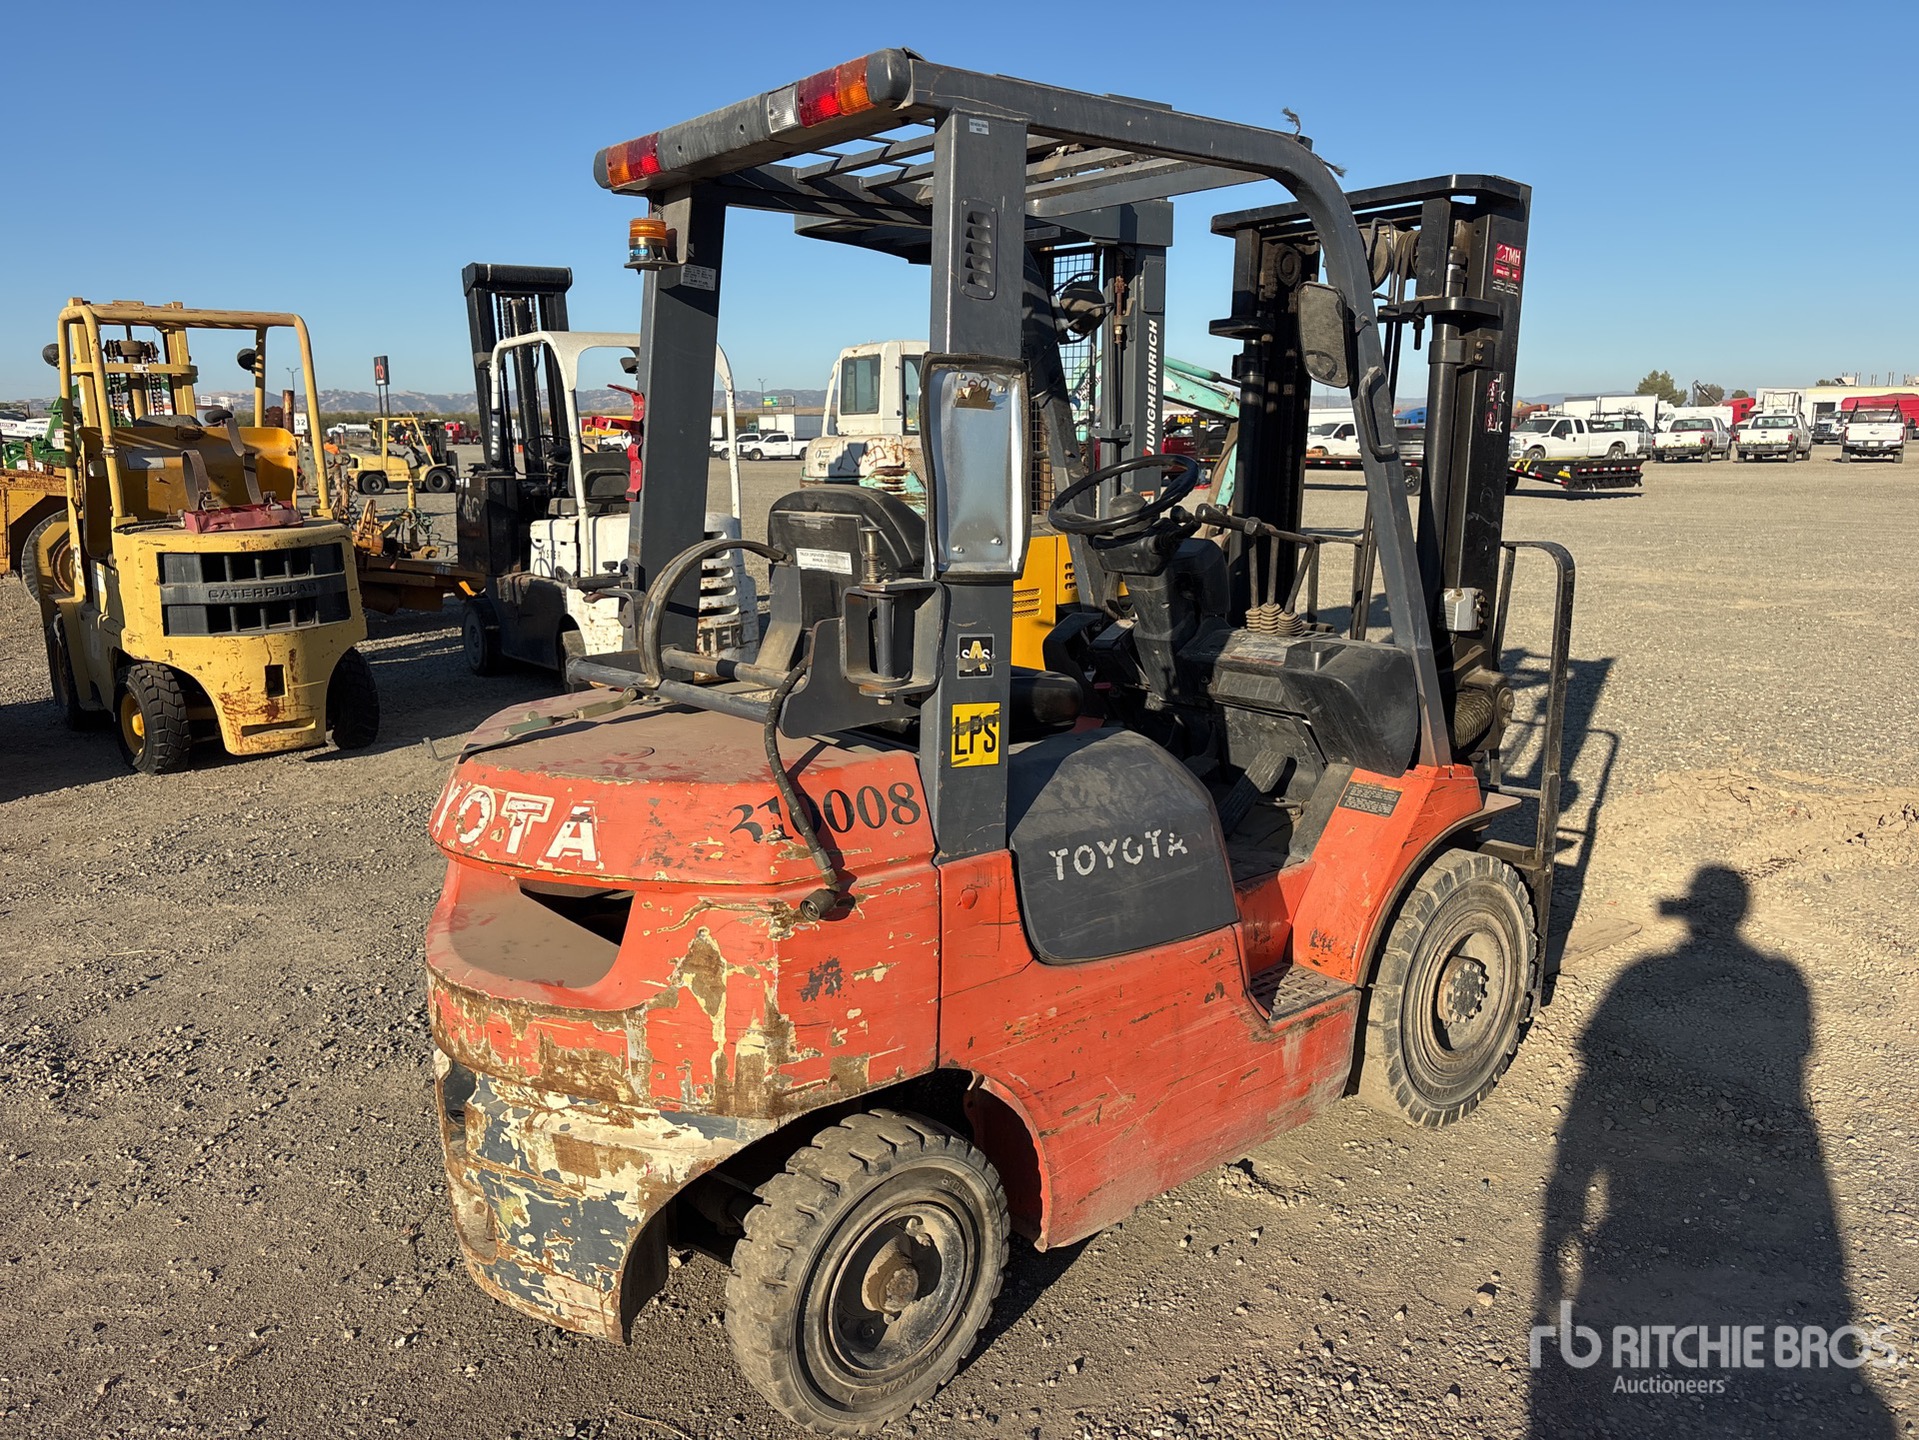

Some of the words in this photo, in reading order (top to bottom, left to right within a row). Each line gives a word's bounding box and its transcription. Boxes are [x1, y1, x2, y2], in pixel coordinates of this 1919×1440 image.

[1505, 246, 1522, 265] TMH
[1144, 319, 1158, 456] JUNGHEINRICH
[295, 418, 306, 426] 32
[208, 582, 317, 602] CATERPILLAR
[954, 714, 998, 756] LPS
[1048, 828, 1189, 881] TOYOTA
